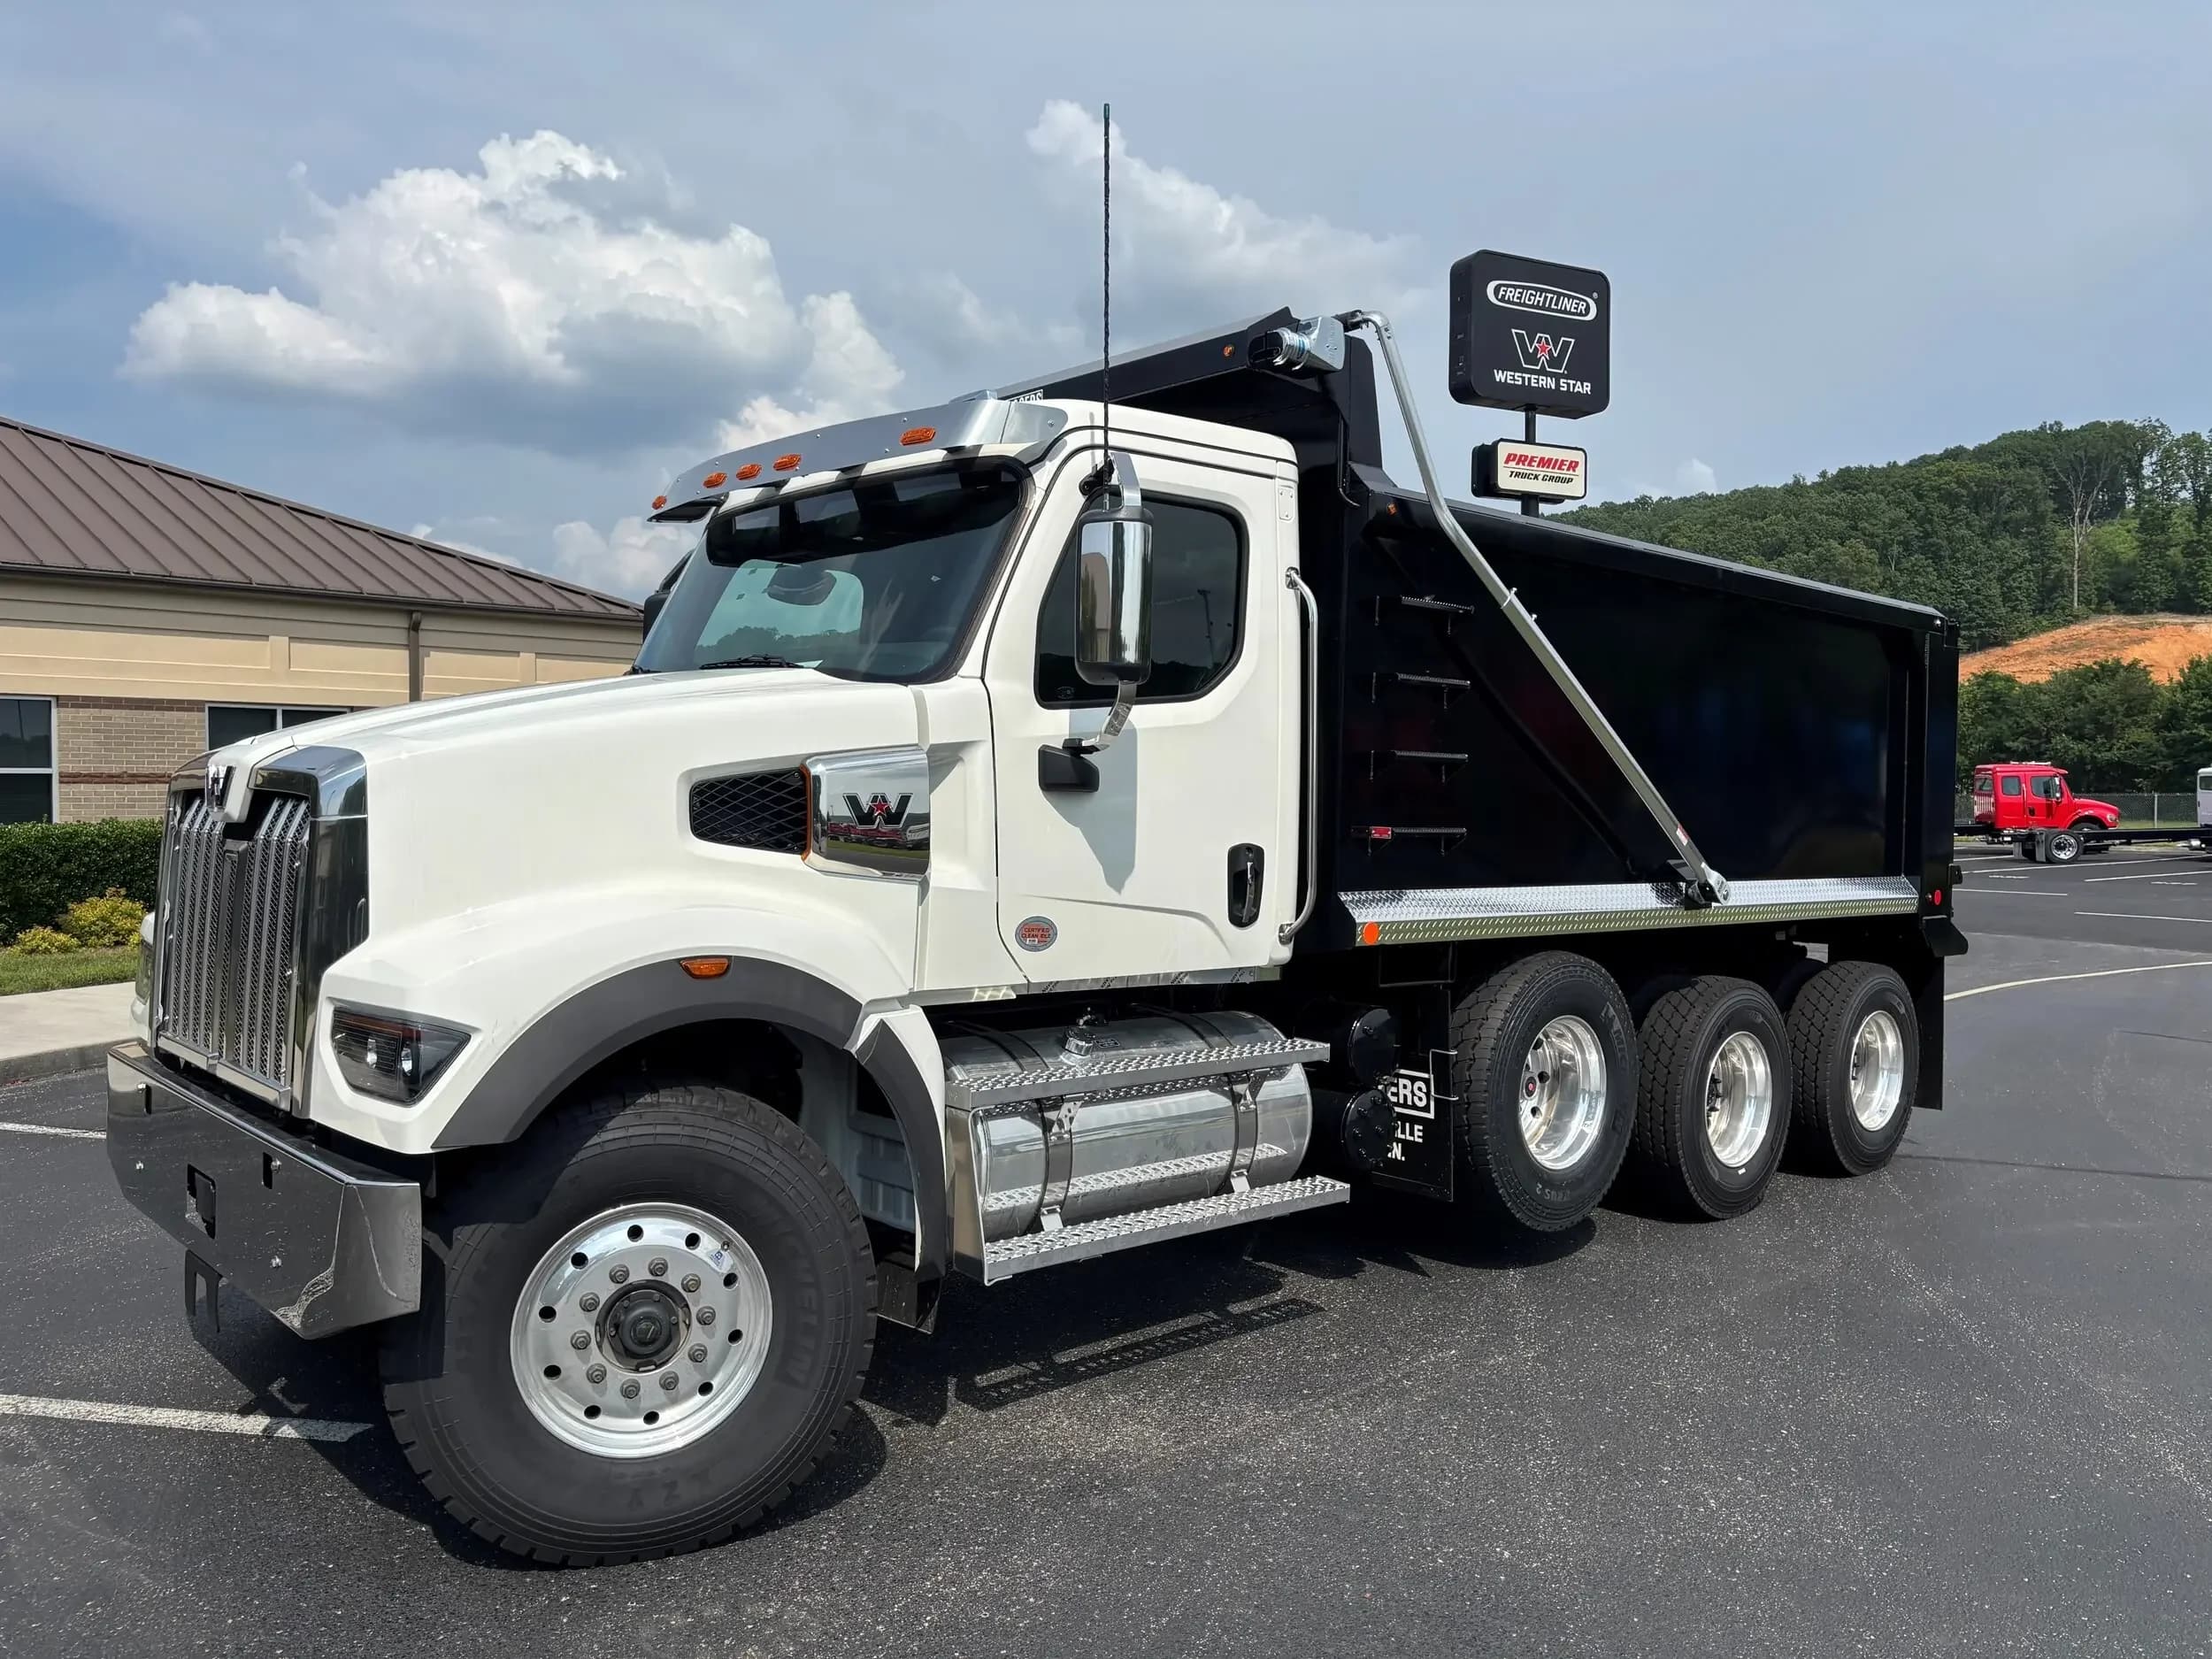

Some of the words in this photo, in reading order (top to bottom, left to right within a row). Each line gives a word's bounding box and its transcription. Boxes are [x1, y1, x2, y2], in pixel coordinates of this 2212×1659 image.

[1497, 287, 1586, 314] FREIGHTLINER
[1494, 369, 1555, 389] WESTERN
[1560, 379, 1592, 395] STAR
[1503, 452, 1580, 472] PREMIER
[1509, 471, 1540, 481] TRUCK
[1540, 473, 1573, 485] GROUP
